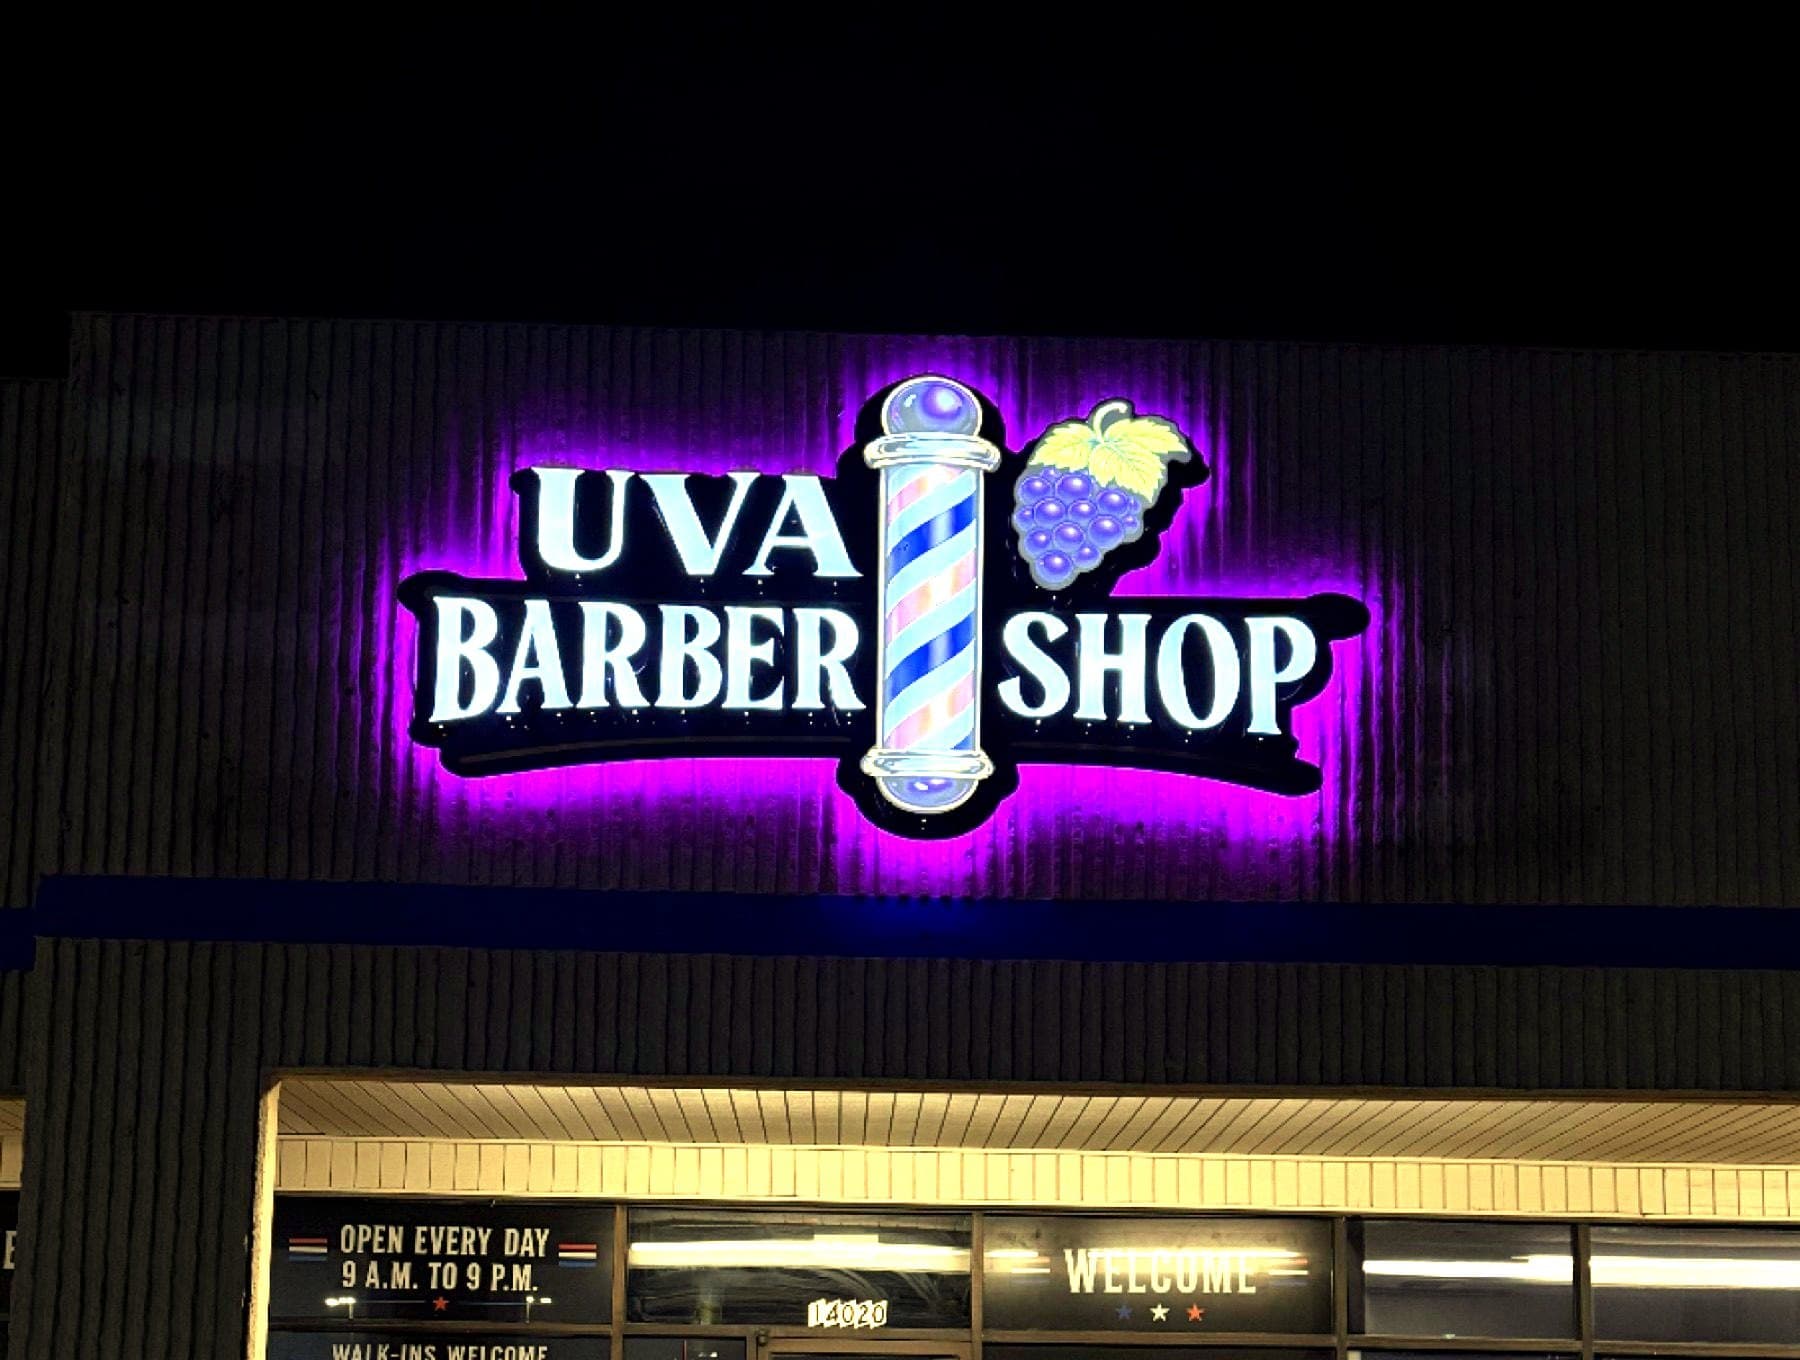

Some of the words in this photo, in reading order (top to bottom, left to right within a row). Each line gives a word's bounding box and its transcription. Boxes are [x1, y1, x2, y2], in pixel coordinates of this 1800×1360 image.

[530, 466, 862, 578] UVA
[429, 595, 866, 723] BARBER
[997, 611, 1317, 736] SHOP
[340, 1224, 404, 1254] OPEN
[414, 1226, 493, 1256] EVERY
[504, 1228, 550, 1258] DAY
[342, 1260, 357, 1288] 9
[365, 1261, 419, 1290] A.M.
[428, 1262, 458, 1290] TO
[466, 1262, 481, 1290] 9
[490, 1263, 539, 1292] P.M.
[1064, 1247, 1257, 1294] WELCOME
[811, 1301, 886, 1327] 14020
